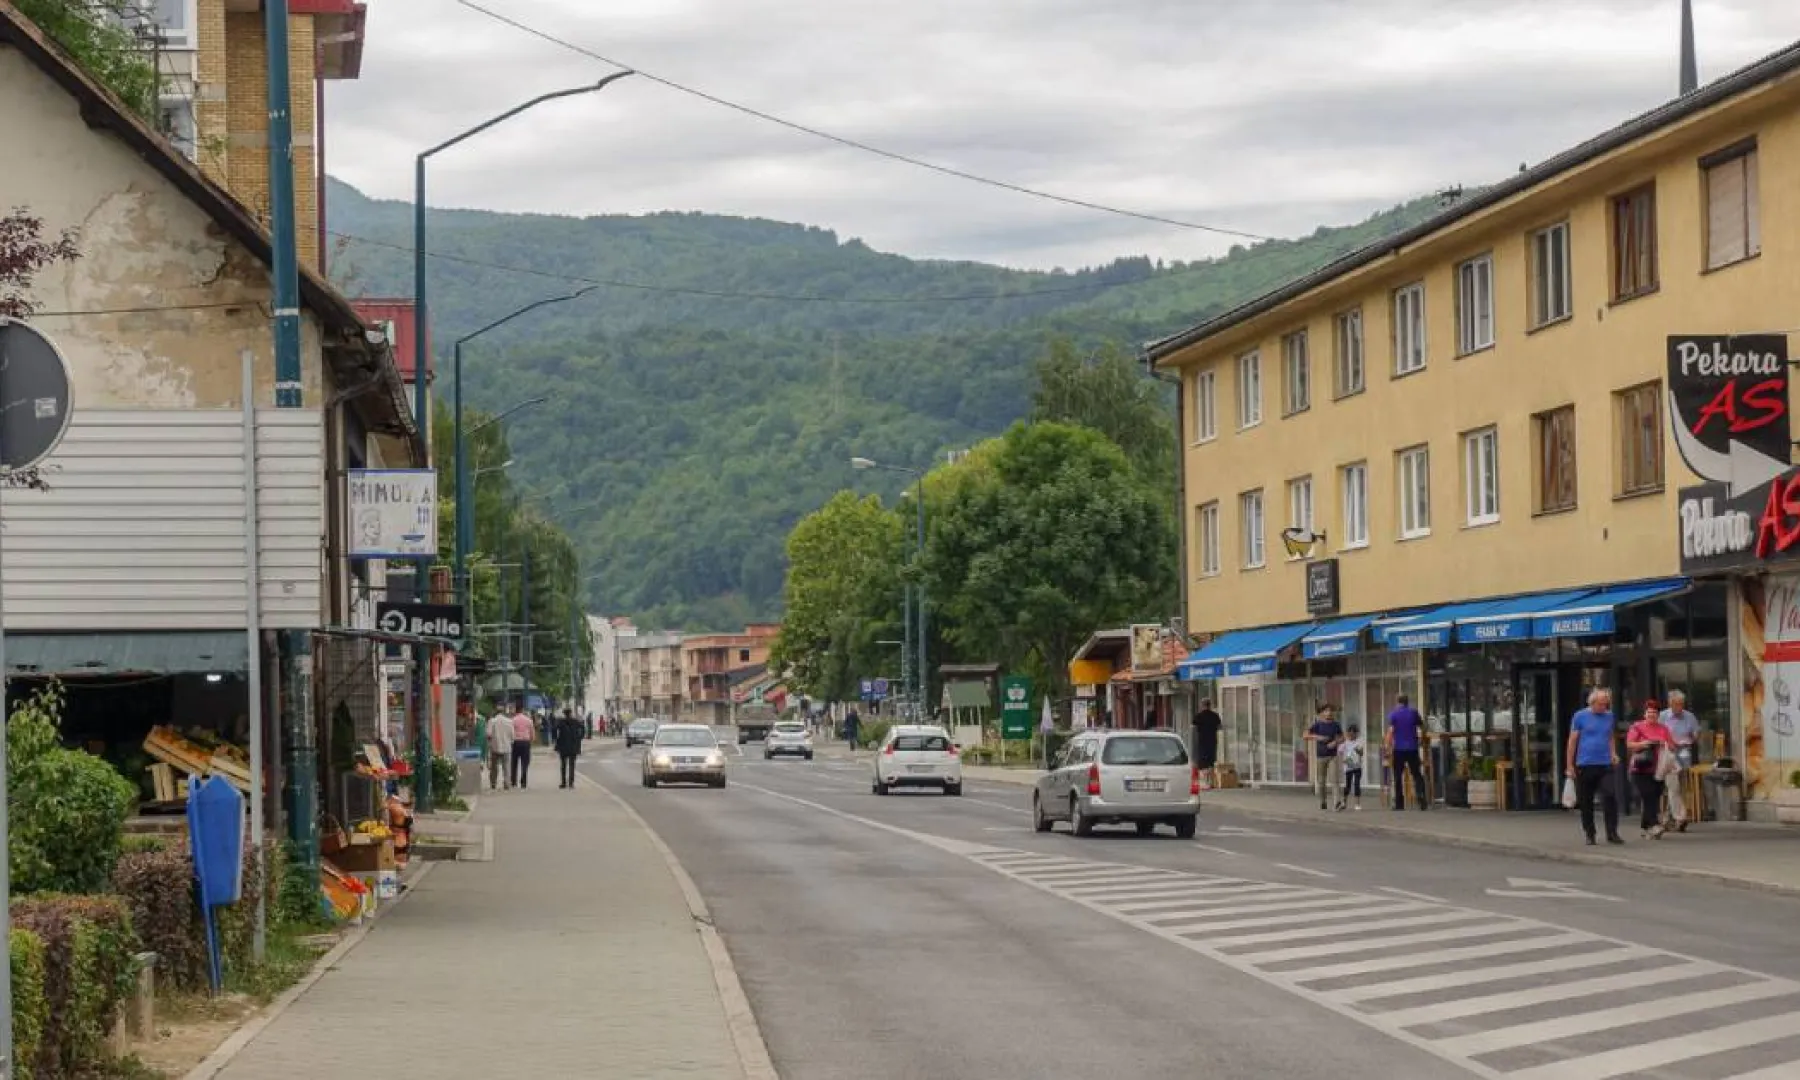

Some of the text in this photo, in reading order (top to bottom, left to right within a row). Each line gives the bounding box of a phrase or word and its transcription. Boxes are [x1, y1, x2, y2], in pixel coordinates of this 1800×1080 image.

[1676, 341, 1781, 376] Pekara
[1690, 378, 1786, 434] AS
[1680, 497, 1754, 558] Pekara
[410, 616, 460, 636] Bella
